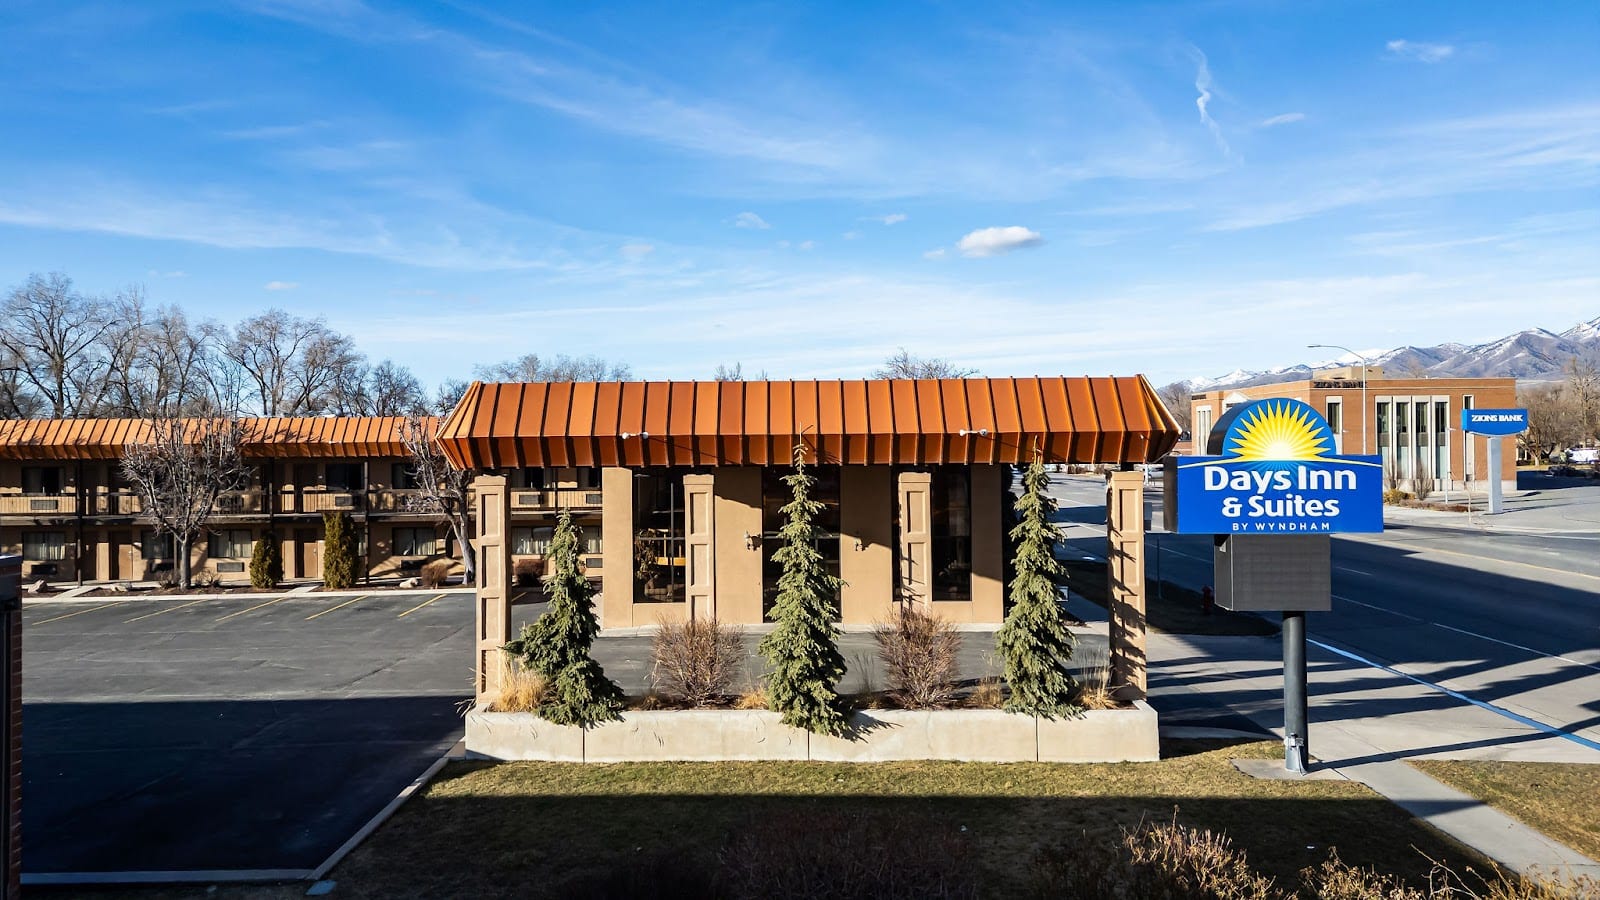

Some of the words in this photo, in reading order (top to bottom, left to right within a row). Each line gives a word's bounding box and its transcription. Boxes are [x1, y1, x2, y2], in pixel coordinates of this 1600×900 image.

[1471, 414, 1498, 422] ZIONS
[1499, 414, 1523, 422] BANK
[1204, 466, 1291, 494] Days
[1297, 465, 1357, 490] Inn
[1222, 496, 1242, 517] &
[1248, 494, 1340, 517] Suites
[1232, 522, 1248, 531] BY
[1255, 522, 1331, 531] WYNDHAM
